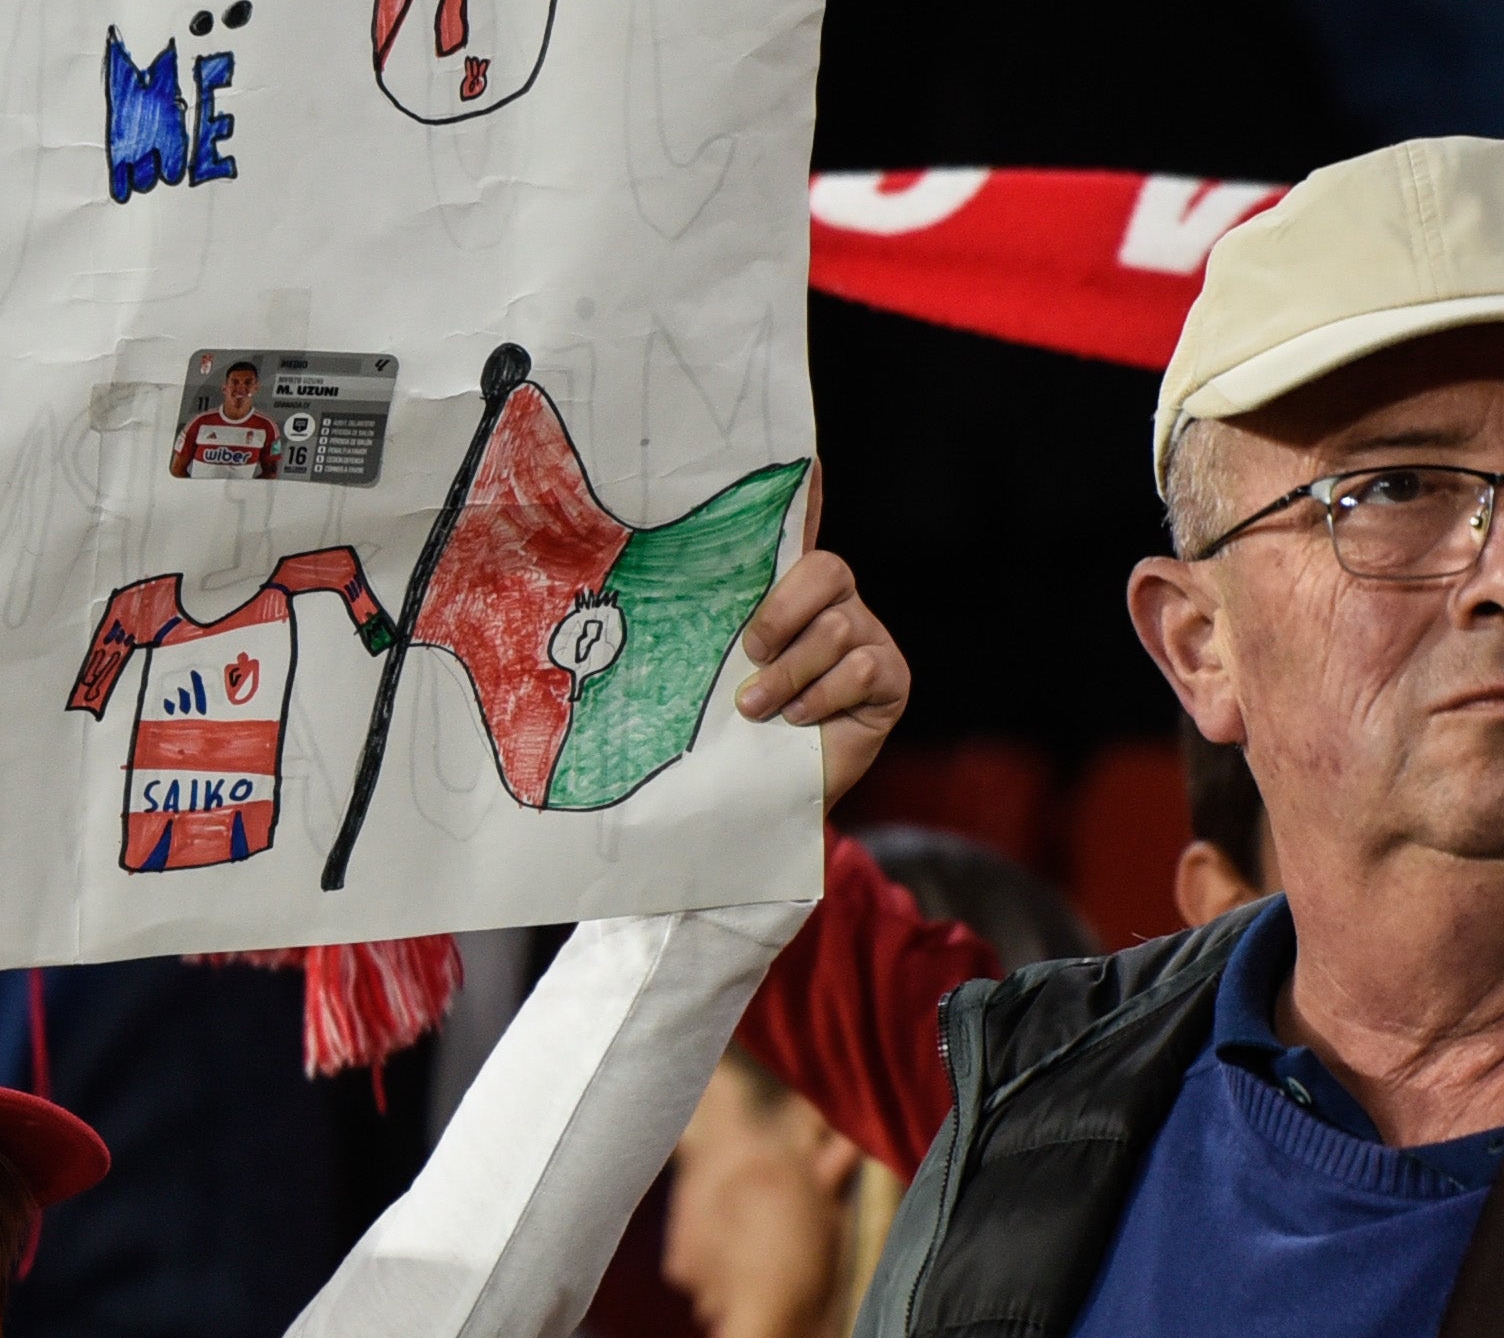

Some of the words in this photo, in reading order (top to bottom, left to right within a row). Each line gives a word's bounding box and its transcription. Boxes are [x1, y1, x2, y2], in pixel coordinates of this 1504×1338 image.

[104, 0, 253, 202] MË
[276, 385, 293, 395] M.
[296, 385, 340, 397] UZUNI
[202, 447, 253, 465] wiber
[288, 446, 308, 465] 16
[142, 777, 255, 814] SAIKO
